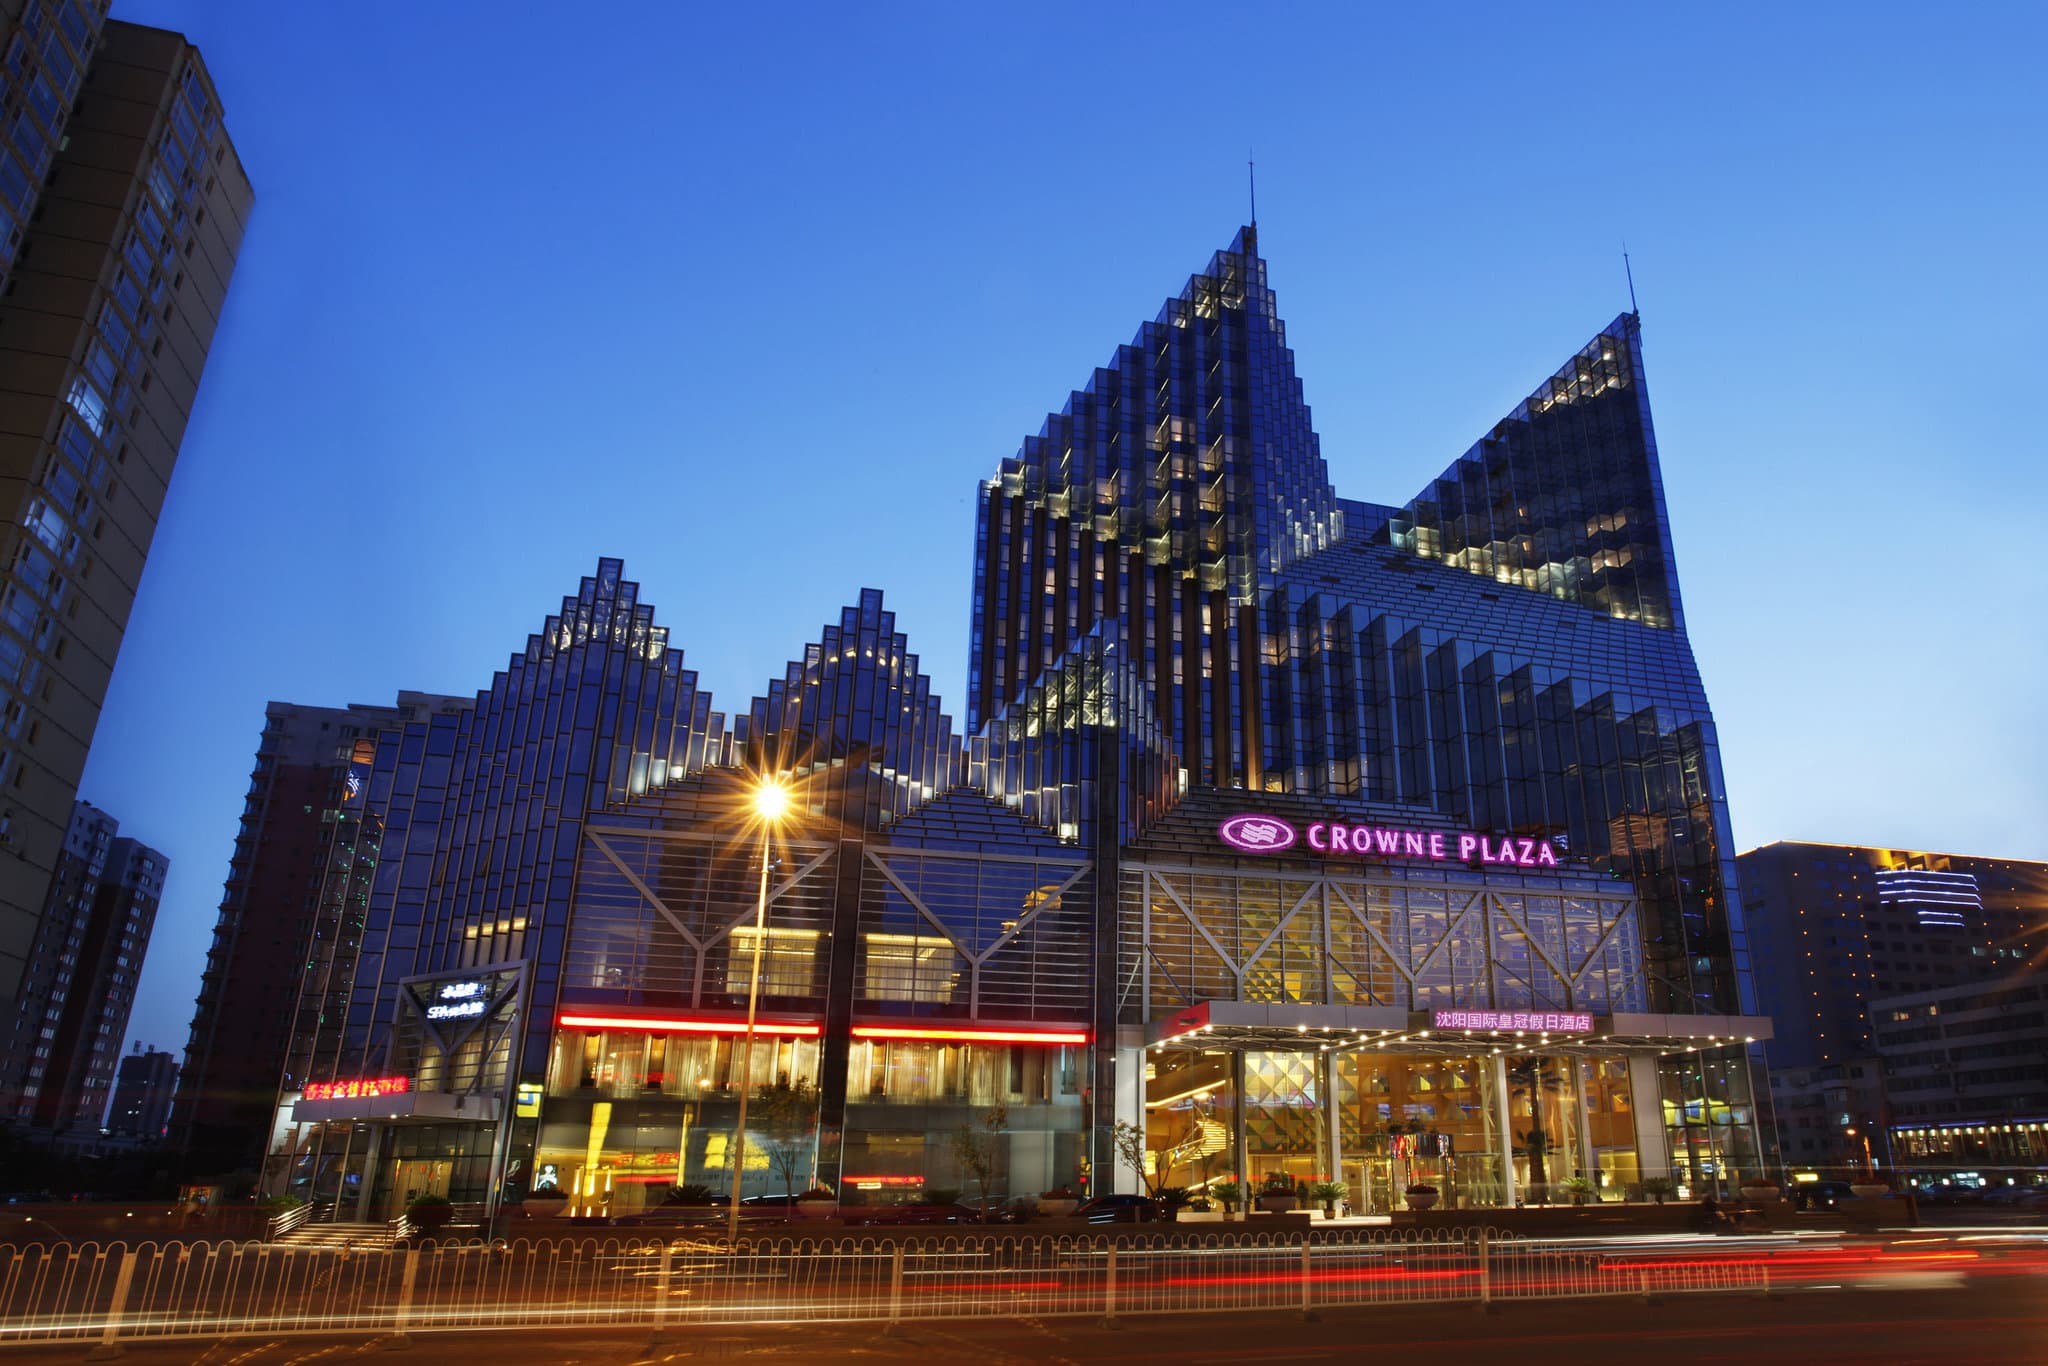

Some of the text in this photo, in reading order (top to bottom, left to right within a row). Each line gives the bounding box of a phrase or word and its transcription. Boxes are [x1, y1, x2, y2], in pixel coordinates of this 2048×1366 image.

[1309, 824, 1556, 865] CROWNE PLAZA
[1435, 1011, 1590, 1030] 沈阳国际皇冠假日酒店
